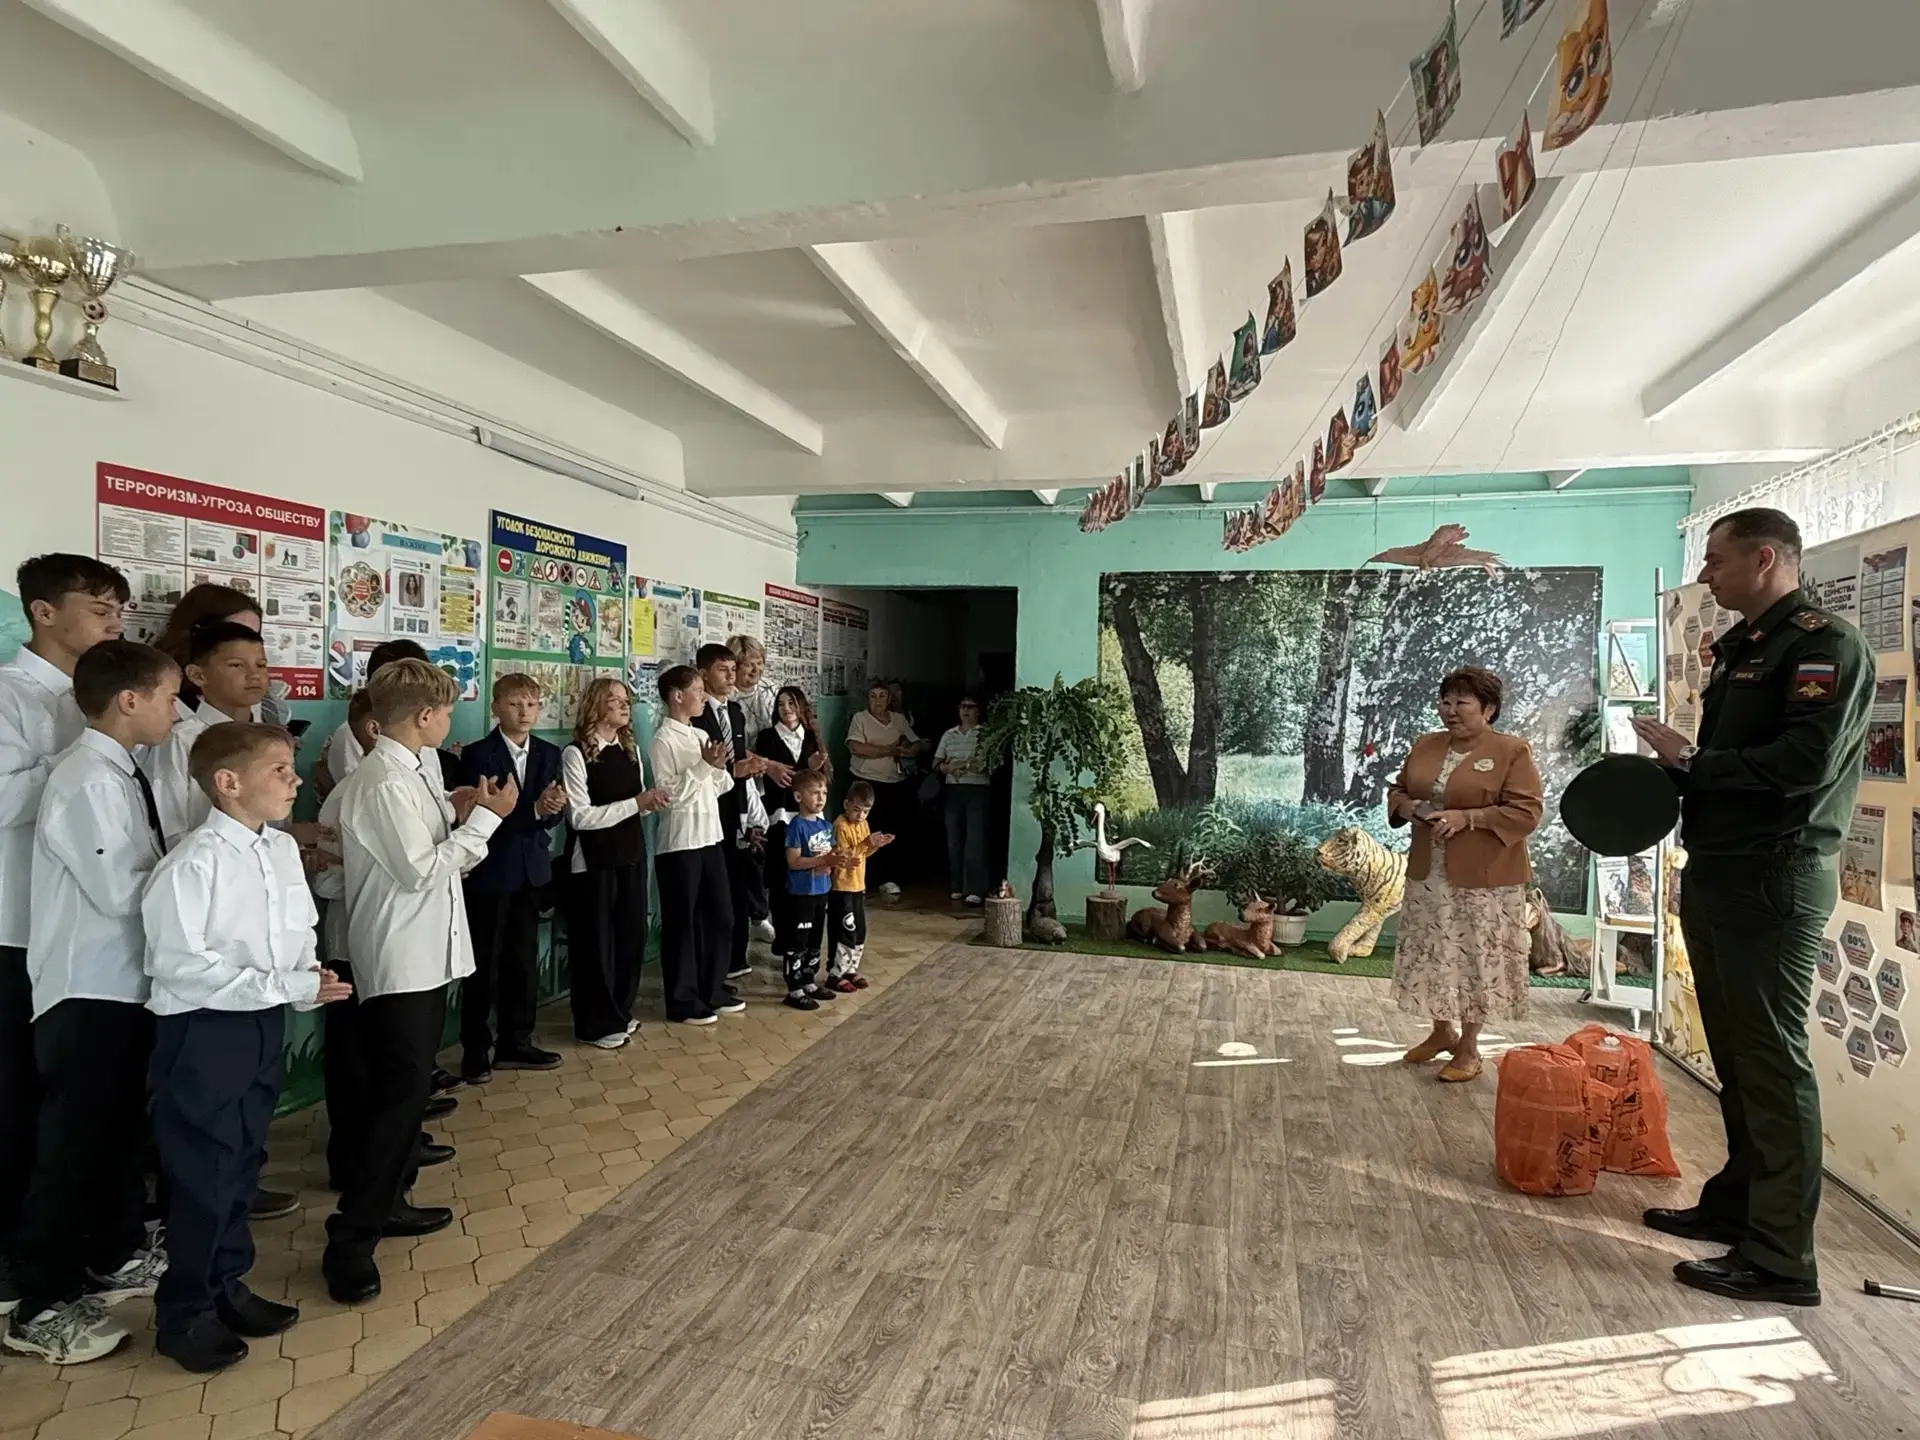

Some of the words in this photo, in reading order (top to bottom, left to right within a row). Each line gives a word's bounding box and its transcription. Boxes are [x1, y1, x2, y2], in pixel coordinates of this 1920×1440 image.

[104, 475, 252, 515] ТЕРРОРИЗМ-УГРОЗА
[255, 505, 321, 529] ОБЩЕСТВУ
[497, 516, 524, 534] УГОЛОК
[526, 525, 575, 546] БЕЗОПАСНОСТИ
[536, 541, 576, 560] ДОРОЖНОГО
[577, 551, 610, 567] ДВИЖЕНИЯ
[1824, 585, 1855, 597] ЕДИНСТВА
[295, 685, 318, 697] 104
[1847, 934, 1866, 948] 80%
